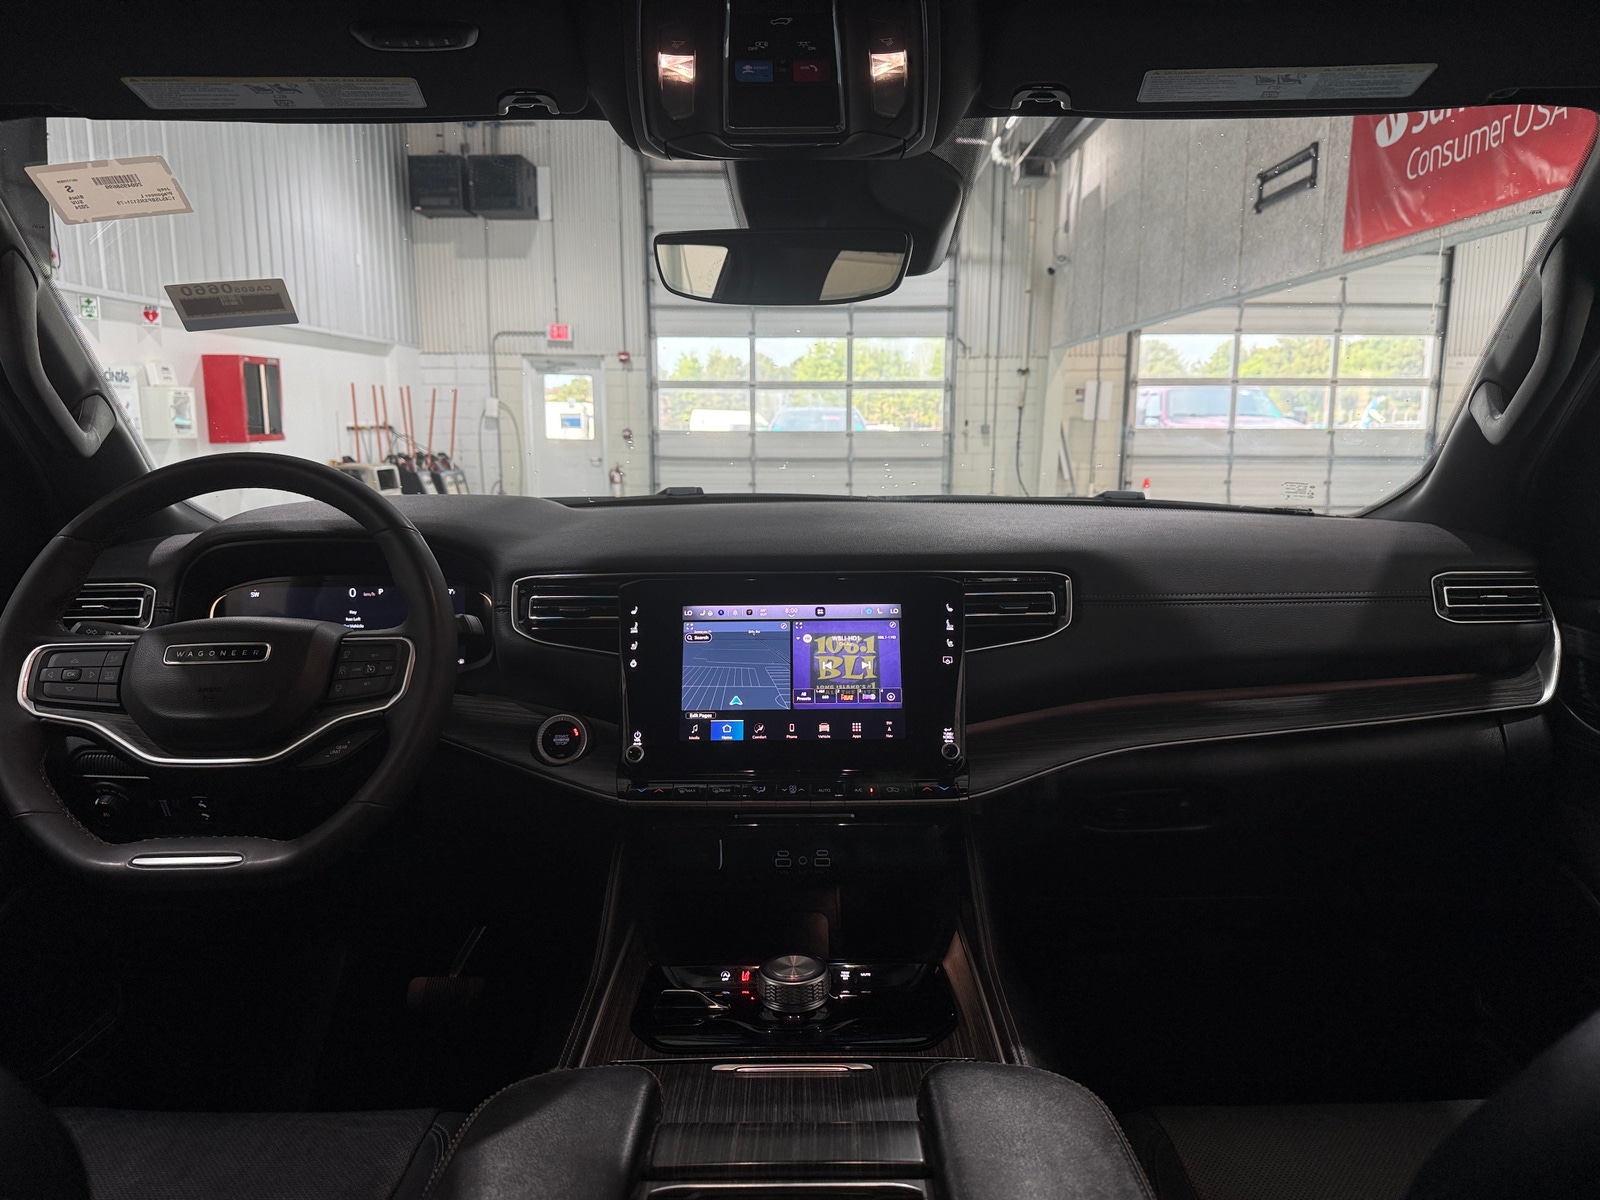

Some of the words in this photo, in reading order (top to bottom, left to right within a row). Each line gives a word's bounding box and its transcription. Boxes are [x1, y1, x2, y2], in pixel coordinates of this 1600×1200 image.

[1406, 114, 1512, 180] Consumer
[1513, 104, 1568, 137] USA
[176, 649, 260, 658] WAGONEER
[813, 655, 878, 680] BLI
